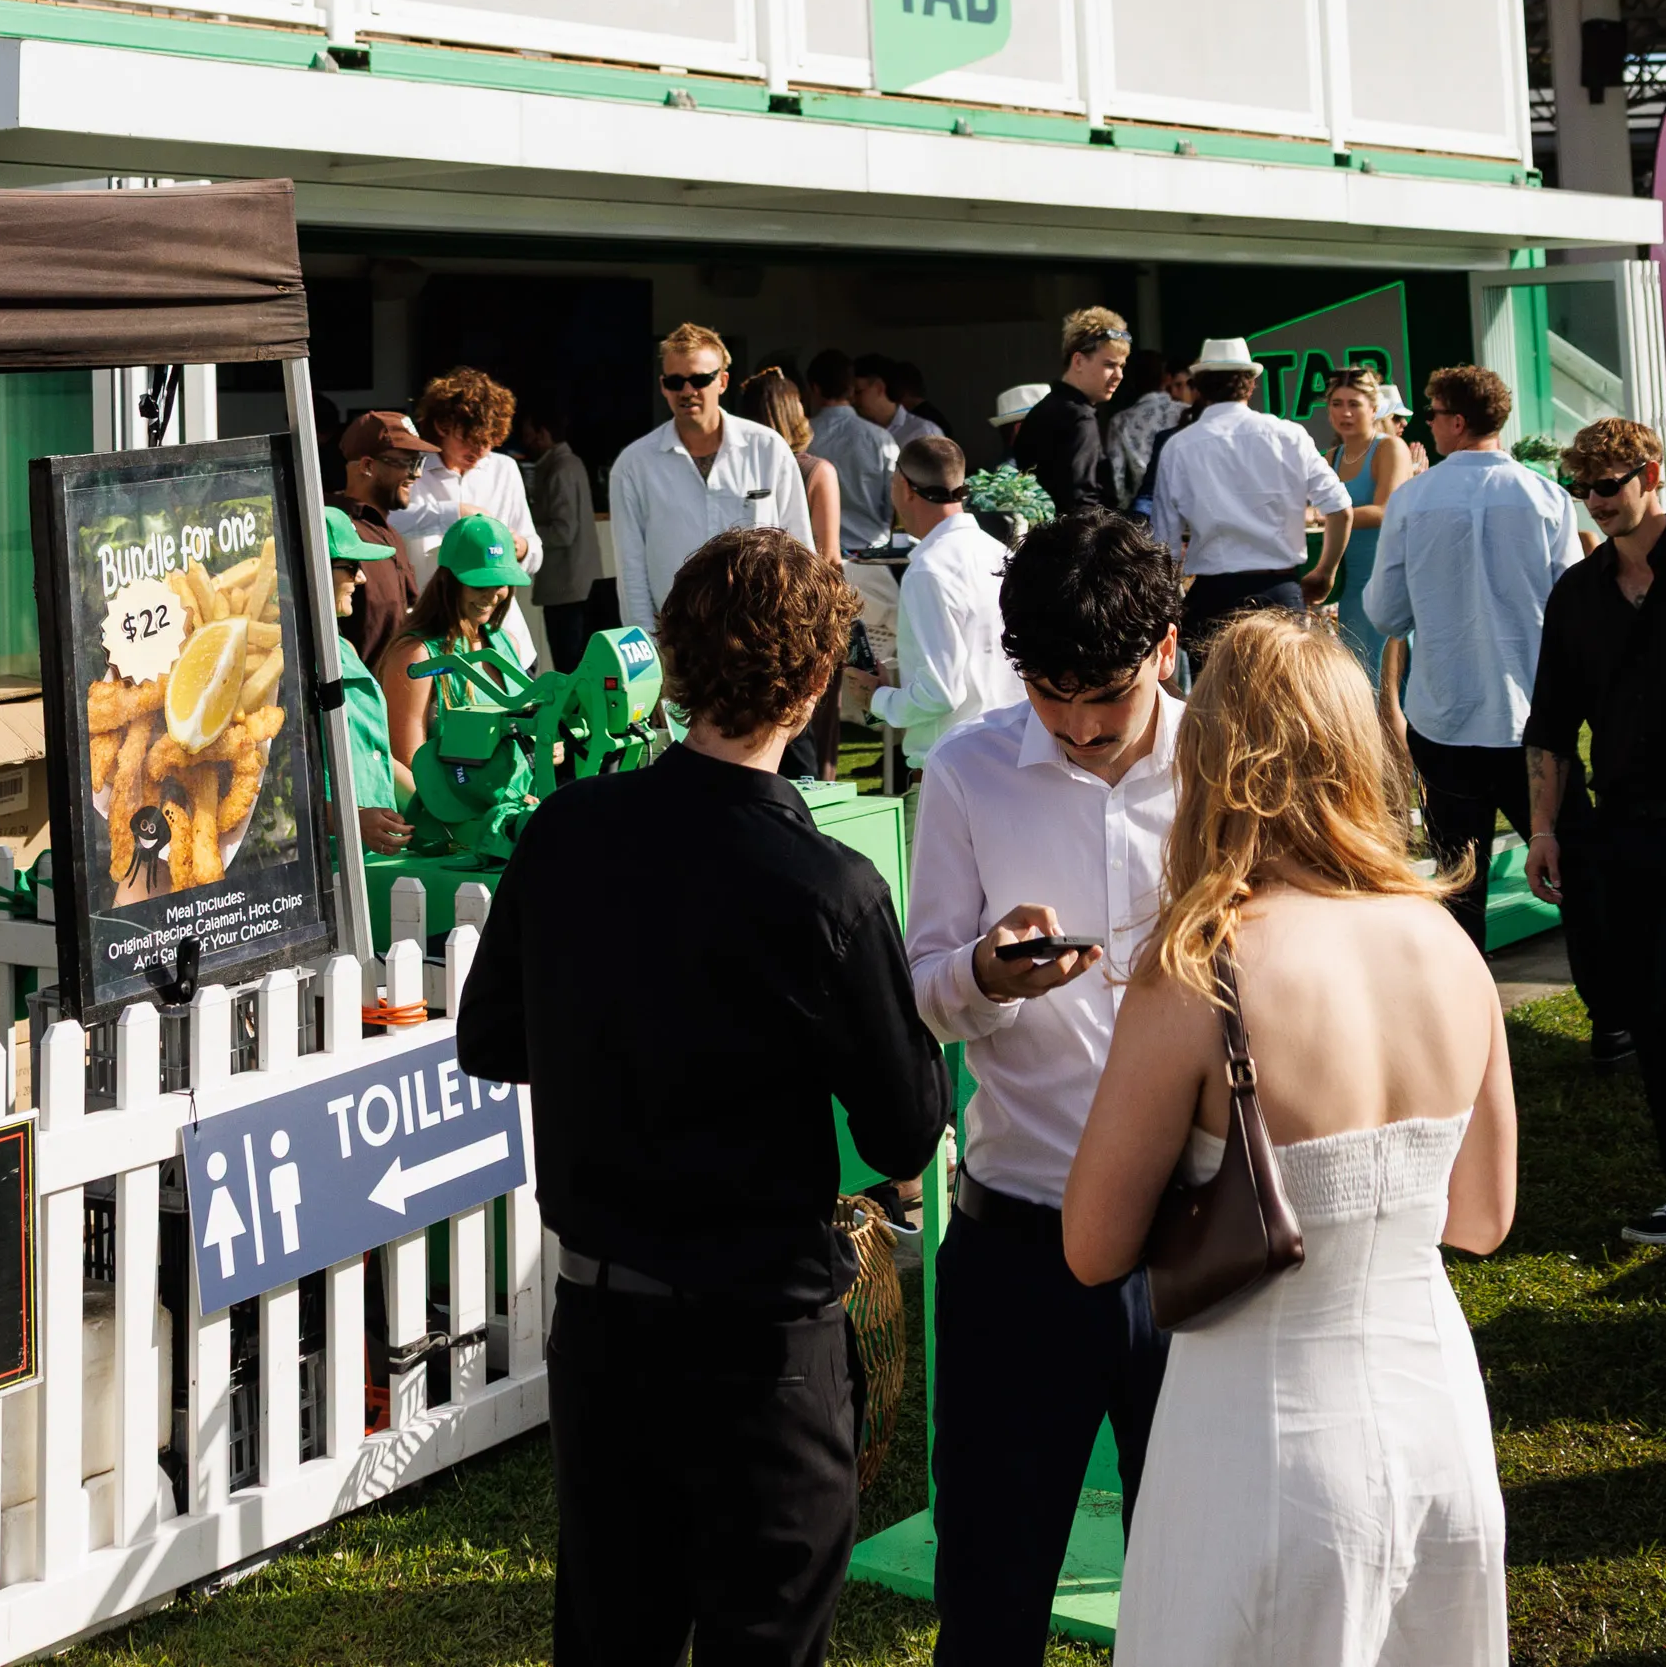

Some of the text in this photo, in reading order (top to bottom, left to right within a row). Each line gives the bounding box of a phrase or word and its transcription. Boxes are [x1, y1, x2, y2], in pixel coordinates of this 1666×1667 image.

[97, 512, 256, 597] Bundle for one
[488, 546, 504, 555] TAB
[122, 604, 171, 643] $22
[619, 640, 654, 664] TAB
[456, 766, 465, 784] TAB
[166, 891, 246, 924] Meal Includes:
[108, 893, 303, 960] Original Recipe Calamari, Hot Chips
[133, 952, 159, 971] And
[211, 931, 238, 951] Your
[240, 919, 282, 942] Choice.
